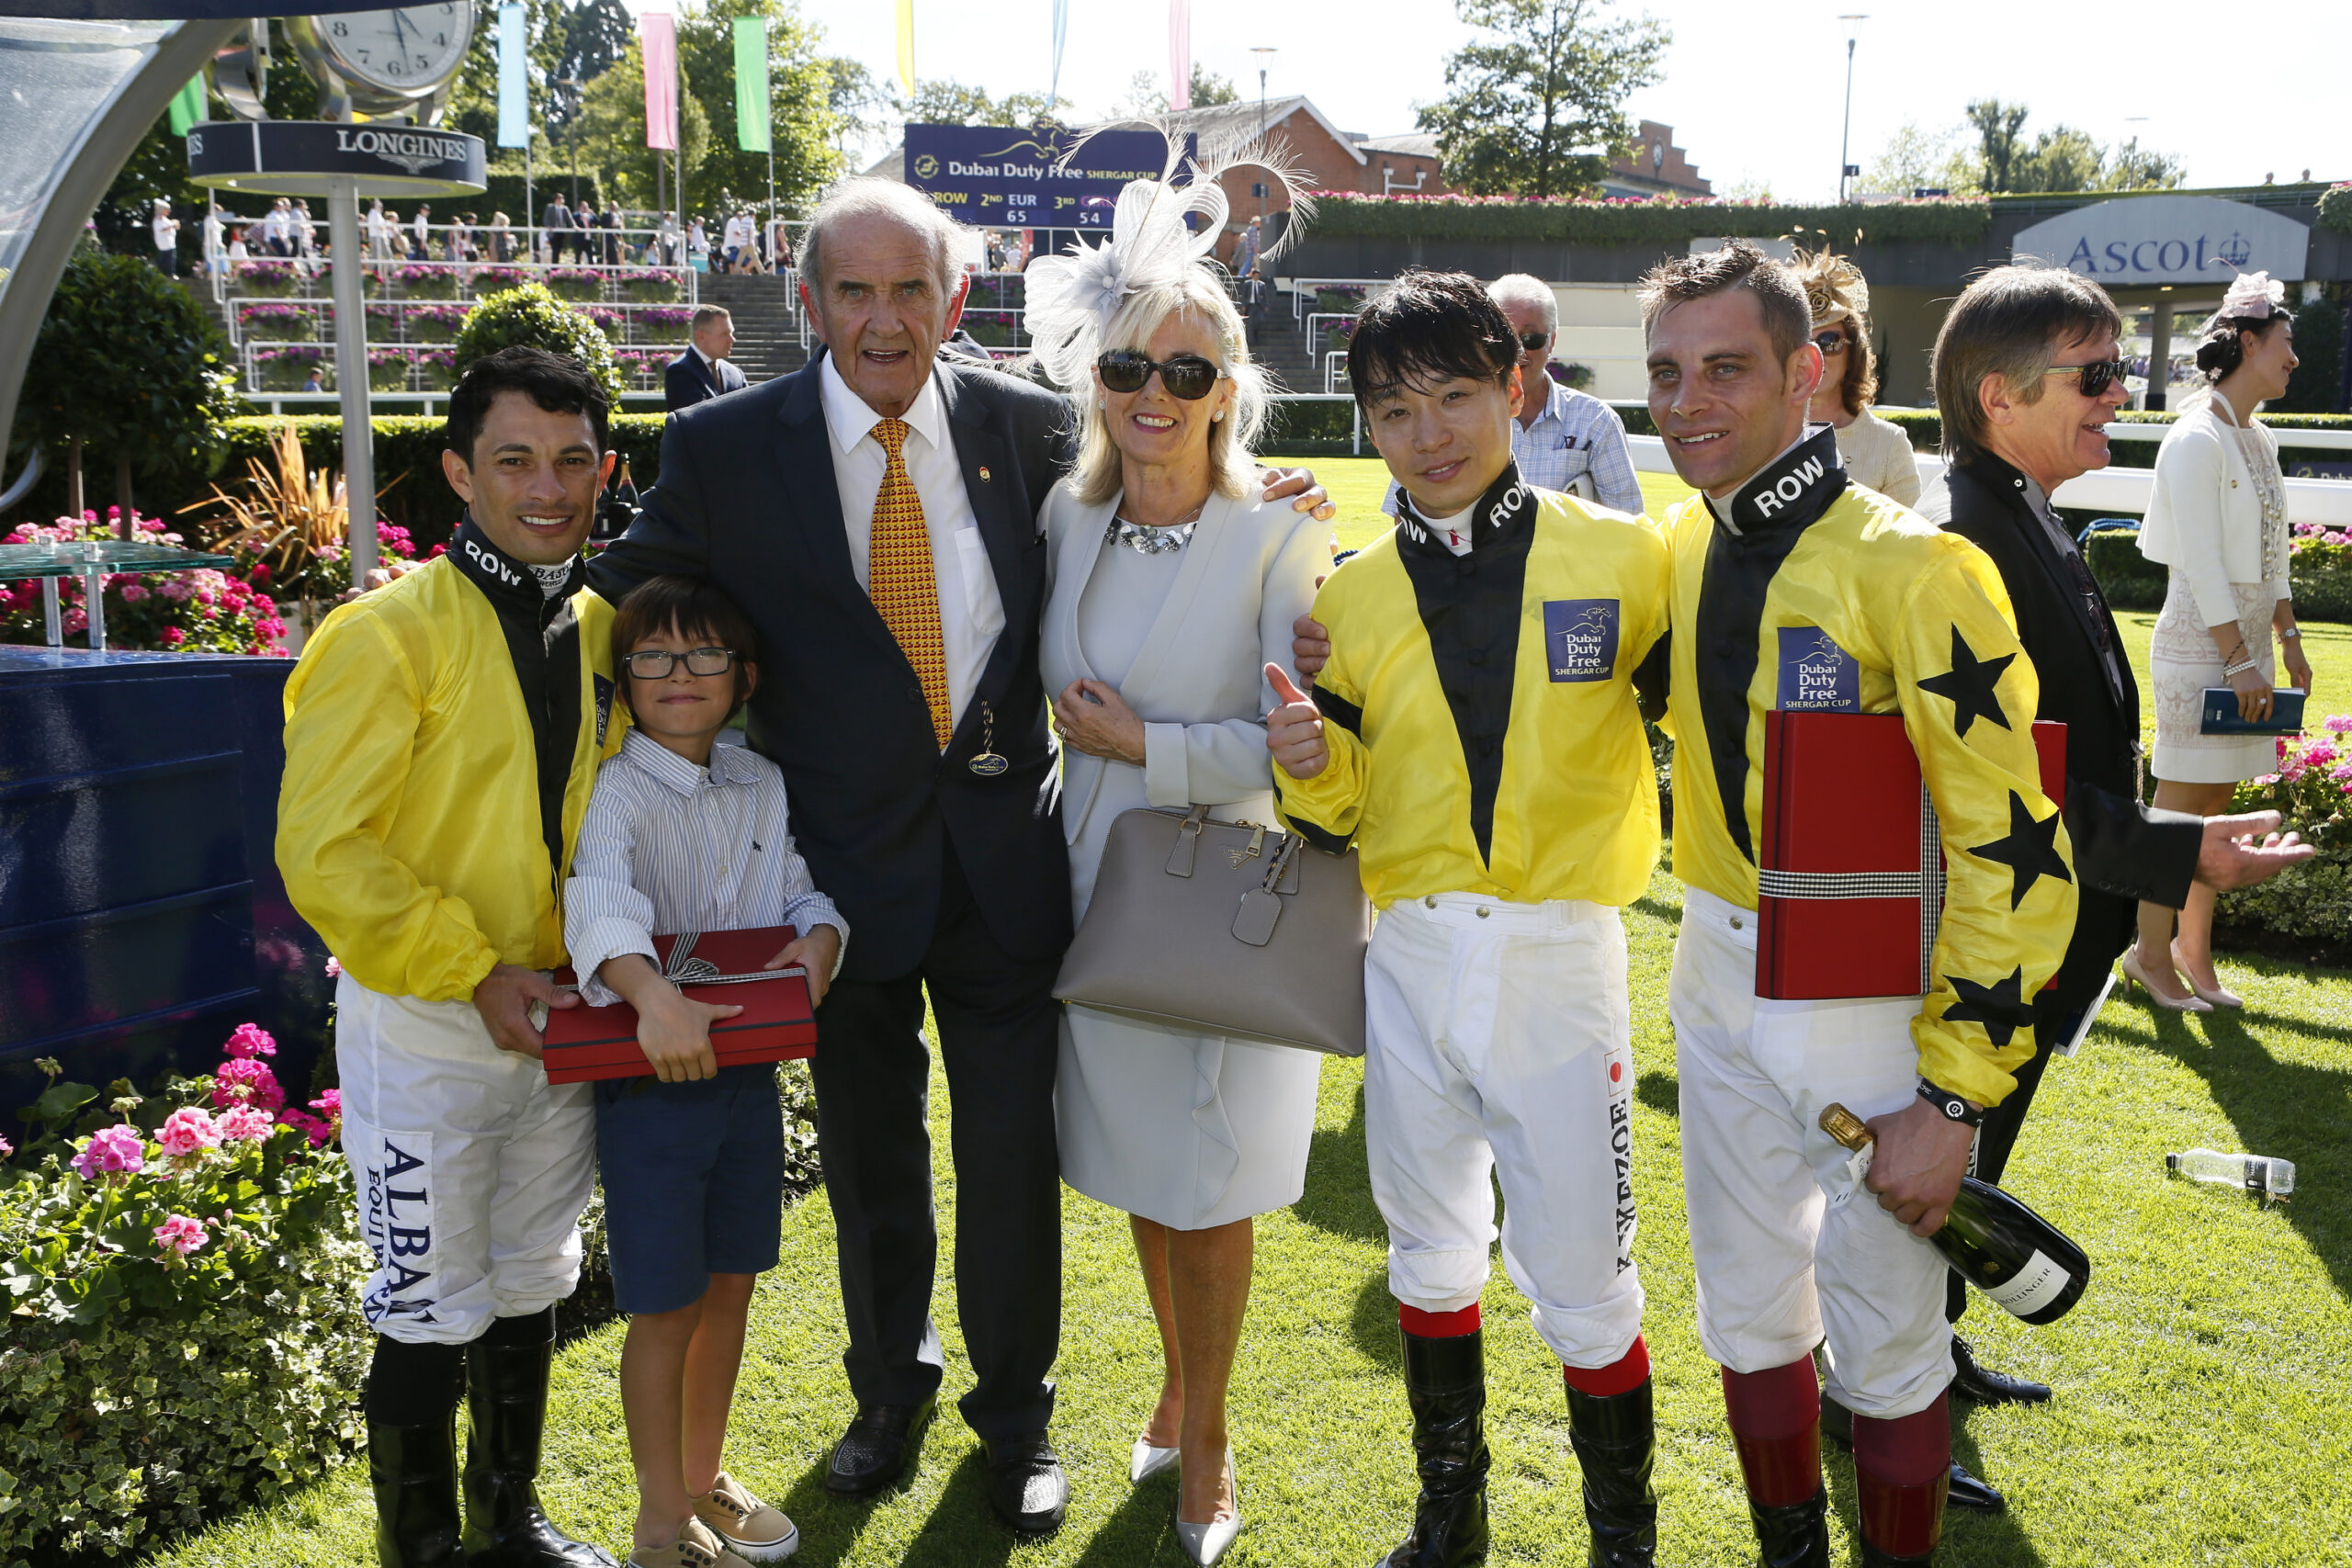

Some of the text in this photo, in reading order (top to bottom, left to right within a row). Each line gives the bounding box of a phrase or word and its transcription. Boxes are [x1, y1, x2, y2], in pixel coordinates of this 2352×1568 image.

[334, 21, 348, 38] 8
[433, 32, 446, 47] 4
[357, 49, 370, 64] 7
[416, 55, 428, 69] 5
[387, 61, 401, 75] 6
[336, 130, 467, 162] LONGINES
[948, 160, 1158, 181] Dubai Duty Free SHERGAR CUP
[933, 191, 967, 204] ROW
[980, 193, 1003, 206] 2ND
[1008, 194, 1037, 206] EUR
[1054, 196, 1076, 209] 3RD
[1007, 209, 1101, 224] 65 54
[1753, 455, 1824, 518] ROW
[1566, 633, 1601, 643] Dubai
[1566, 643, 1601, 657] Duty
[1567, 654, 1600, 667] Free
[1555, 666, 1610, 675] SHERGAR CUP
[1799, 663, 1837, 673] Dubai
[1799, 673, 1837, 688] Duty
[1798, 686, 1838, 700] Free
[1785, 699, 1852, 708] SHERGAR CUP
